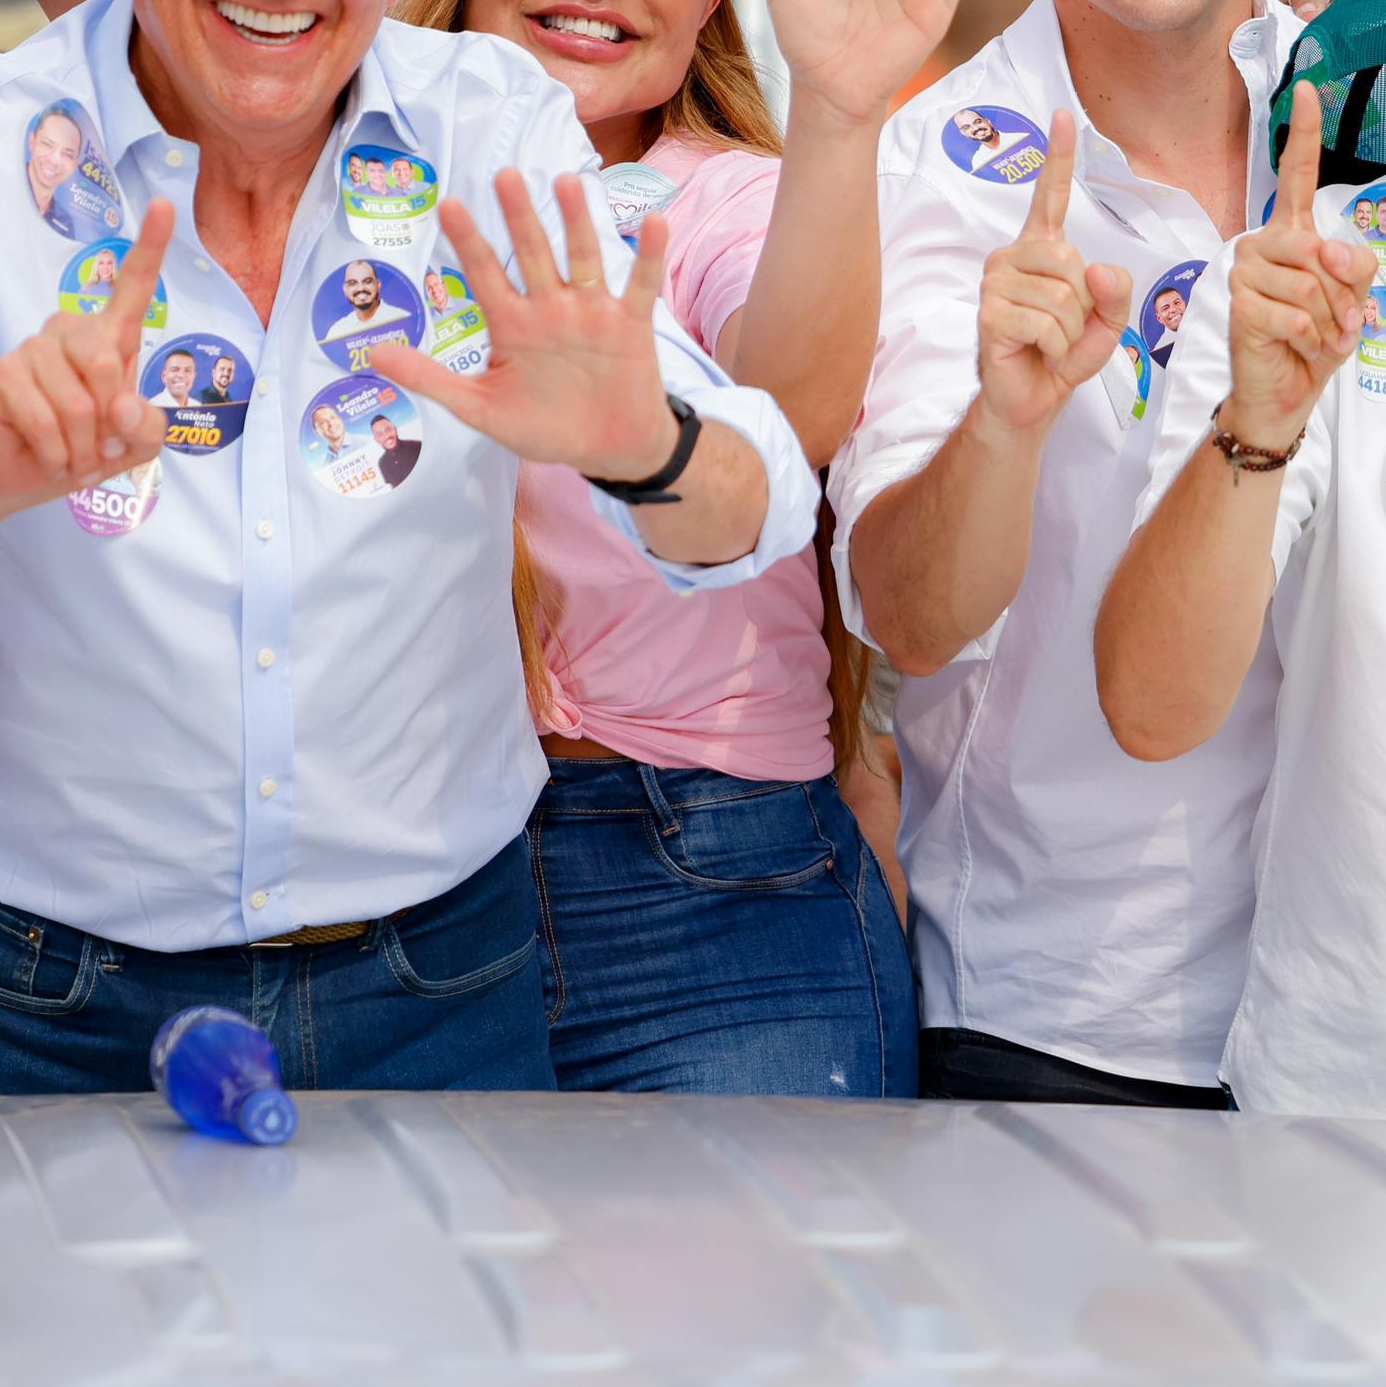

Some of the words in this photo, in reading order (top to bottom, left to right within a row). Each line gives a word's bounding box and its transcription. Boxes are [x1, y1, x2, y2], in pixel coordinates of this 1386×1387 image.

[1000, 148, 1046, 183] 20.500
[70, 183, 107, 209] Leandro
[73, 193, 101, 214] Vilela
[361, 198, 412, 213] VILELA
[410, 195, 427, 210] 15
[373, 236, 412, 247] 27555
[437, 319, 463, 341] ELA
[458, 310, 480, 328] 15
[449, 350, 482, 374] 180
[336, 387, 379, 413] Leandro
[346, 397, 378, 416] Vilela
[375, 388, 398, 406] 15
[164, 424, 222, 446] 27010
[193, 419, 215, 428] Neto
[333, 454, 366, 477] JOHNNY
[339, 467, 377, 494] 11145
